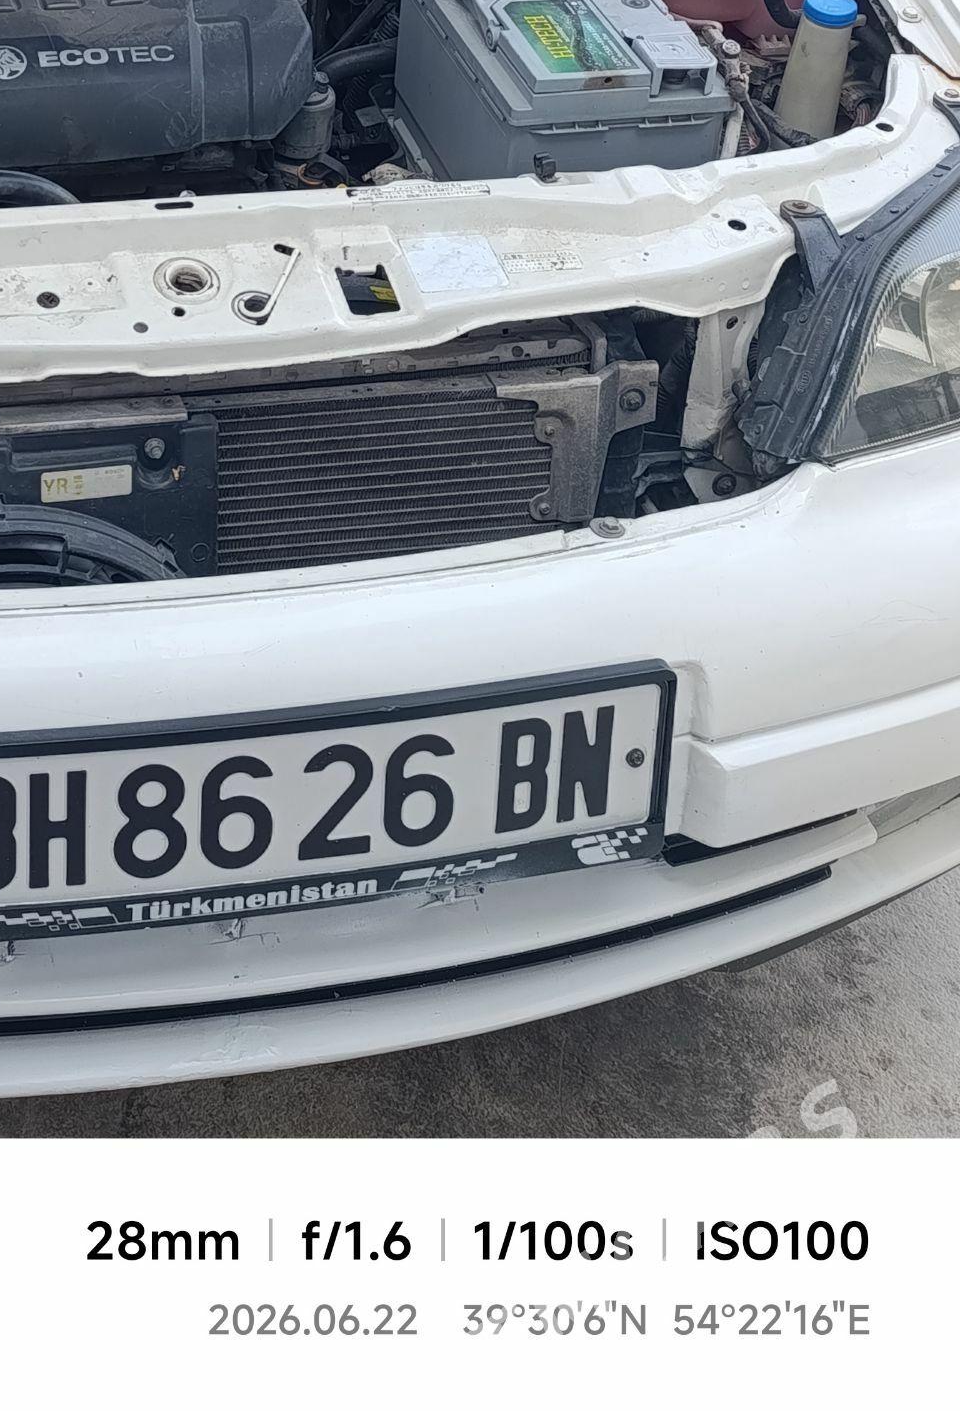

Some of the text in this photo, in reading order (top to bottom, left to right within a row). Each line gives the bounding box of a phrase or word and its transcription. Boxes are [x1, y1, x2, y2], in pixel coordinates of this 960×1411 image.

[37, 45, 176, 68] ECOTEC
[495, 705, 615, 834] BN
[126, 878, 378, 922] Türkmenistan
